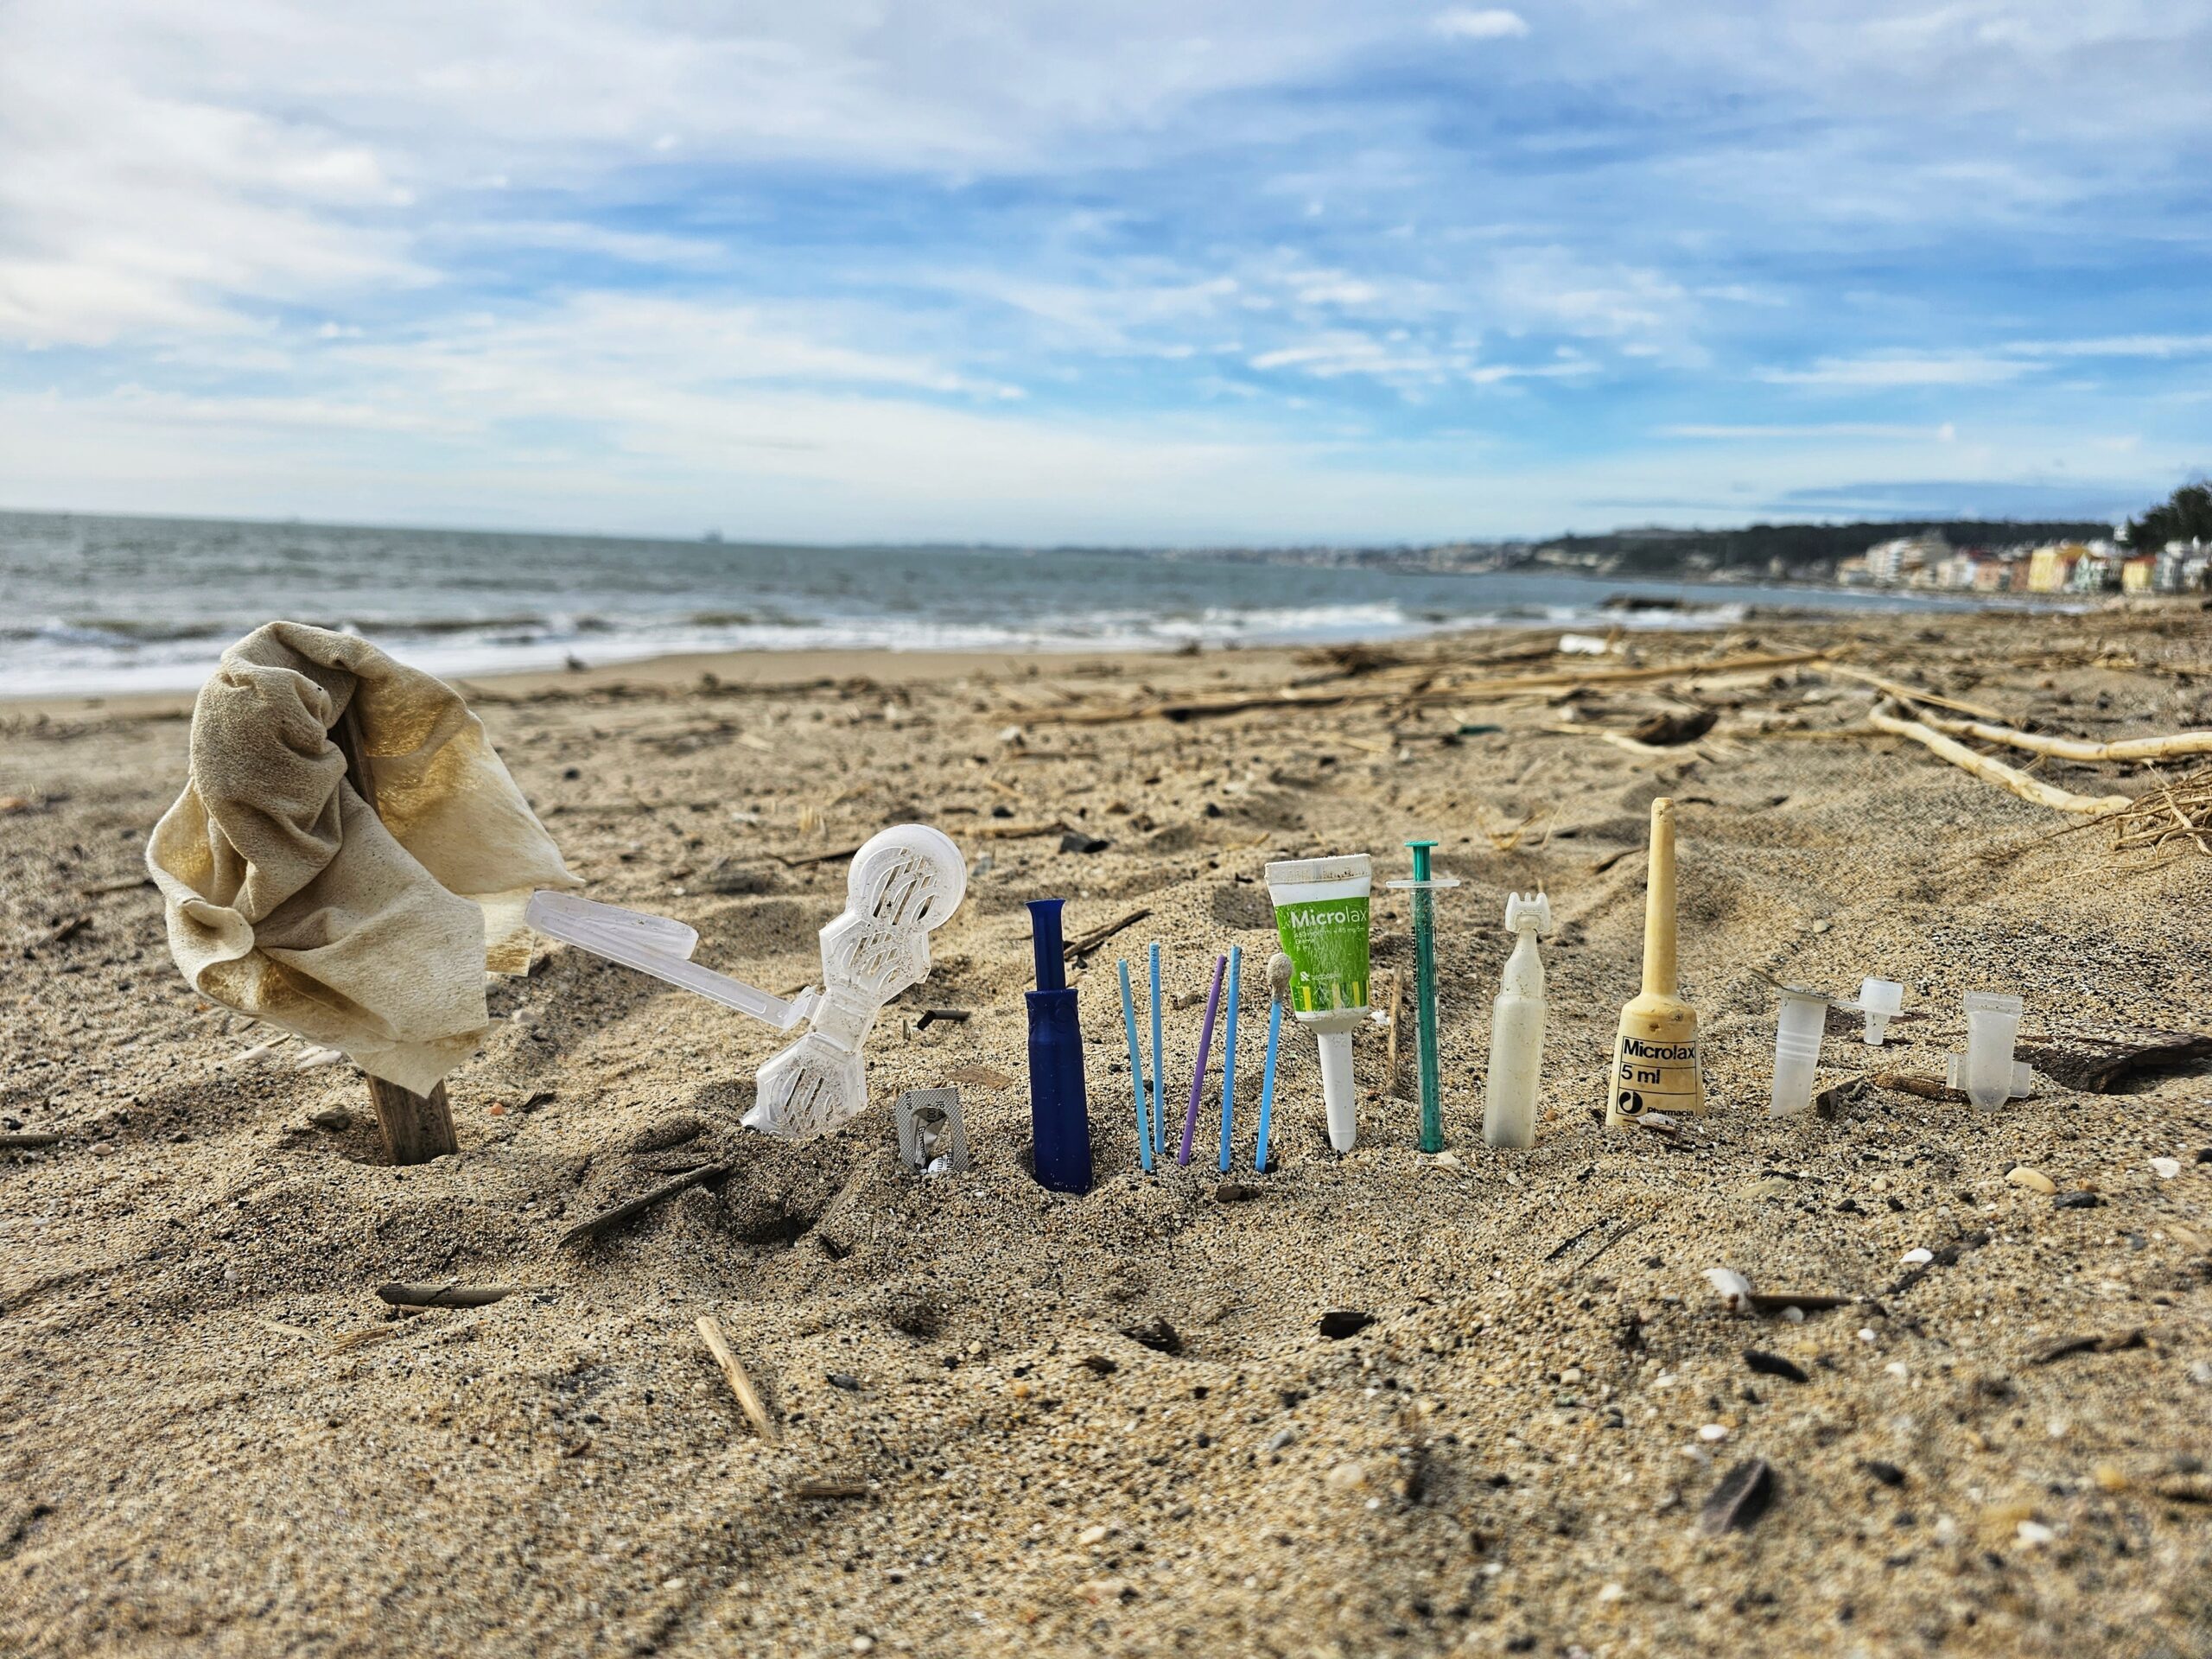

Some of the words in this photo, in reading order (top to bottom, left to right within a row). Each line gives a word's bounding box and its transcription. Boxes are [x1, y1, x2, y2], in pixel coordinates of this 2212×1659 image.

[1290, 906, 1368, 929] Microlax
[1624, 1039, 1695, 1059] Microlax
[1621, 1065, 1633, 1080] 5
[1637, 1070, 1661, 1084] ml
[1647, 1106, 1694, 1116] Pharmacia
